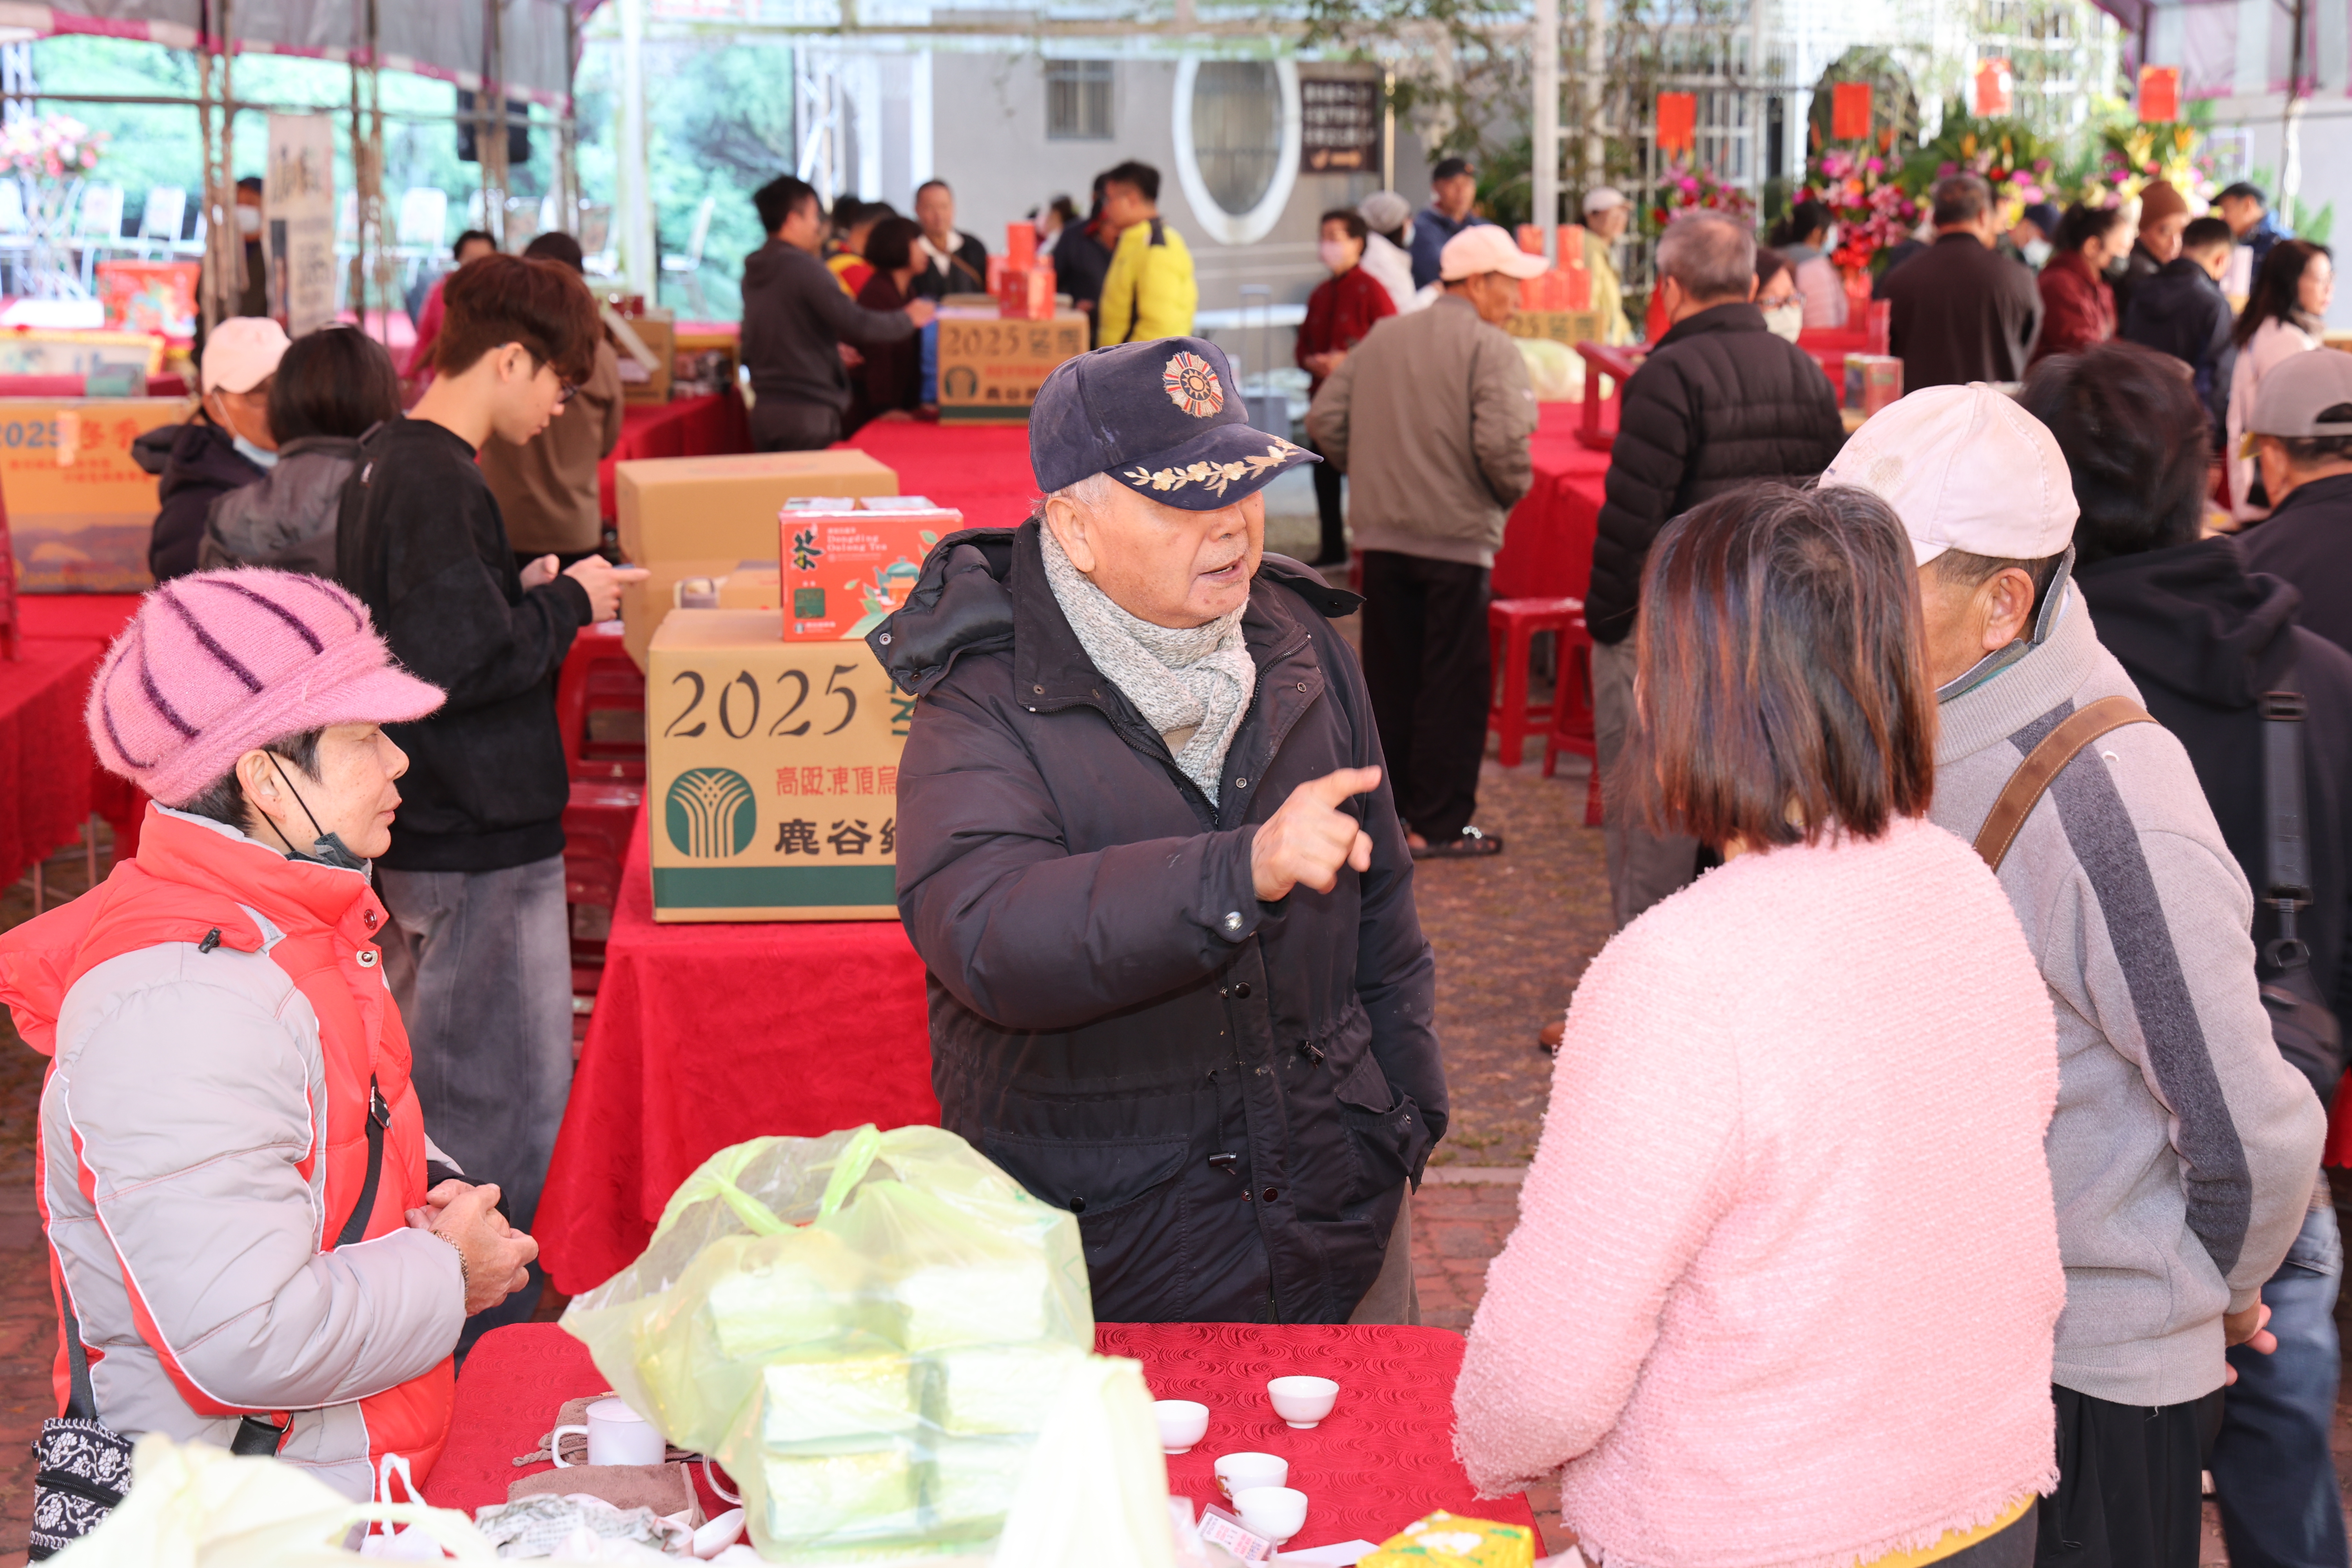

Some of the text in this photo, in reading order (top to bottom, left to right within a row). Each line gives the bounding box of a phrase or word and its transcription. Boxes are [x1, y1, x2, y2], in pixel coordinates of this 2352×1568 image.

[946, 325, 1020, 356] 2025
[0, 420, 62, 448] 025
[793, 528, 823, 570] 茶
[664, 663, 859, 739] 2025
